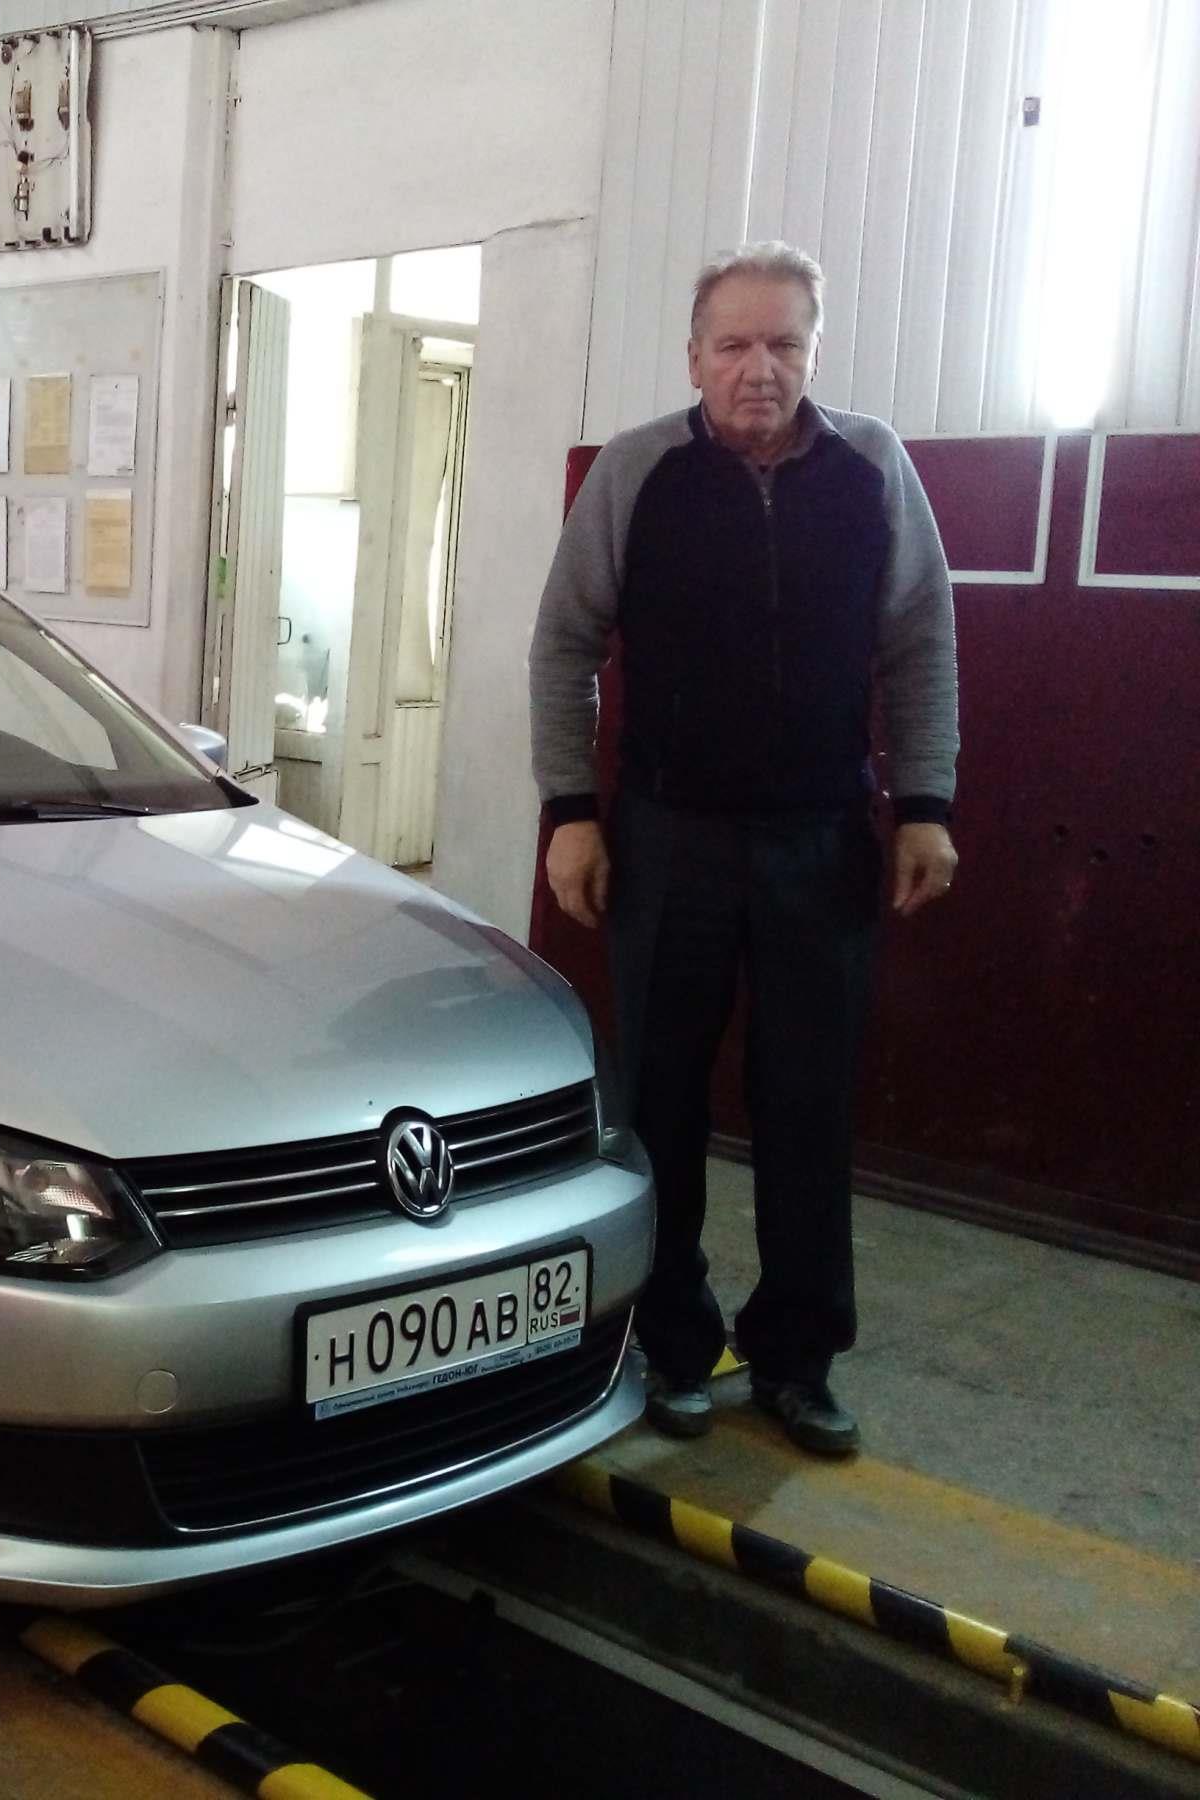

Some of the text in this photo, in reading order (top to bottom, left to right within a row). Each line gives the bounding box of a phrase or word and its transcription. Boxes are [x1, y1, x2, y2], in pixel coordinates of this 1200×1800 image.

[329, 1261, 572, 1386] Н090АВ 82
[529, 1311, 559, 1335] RUS
